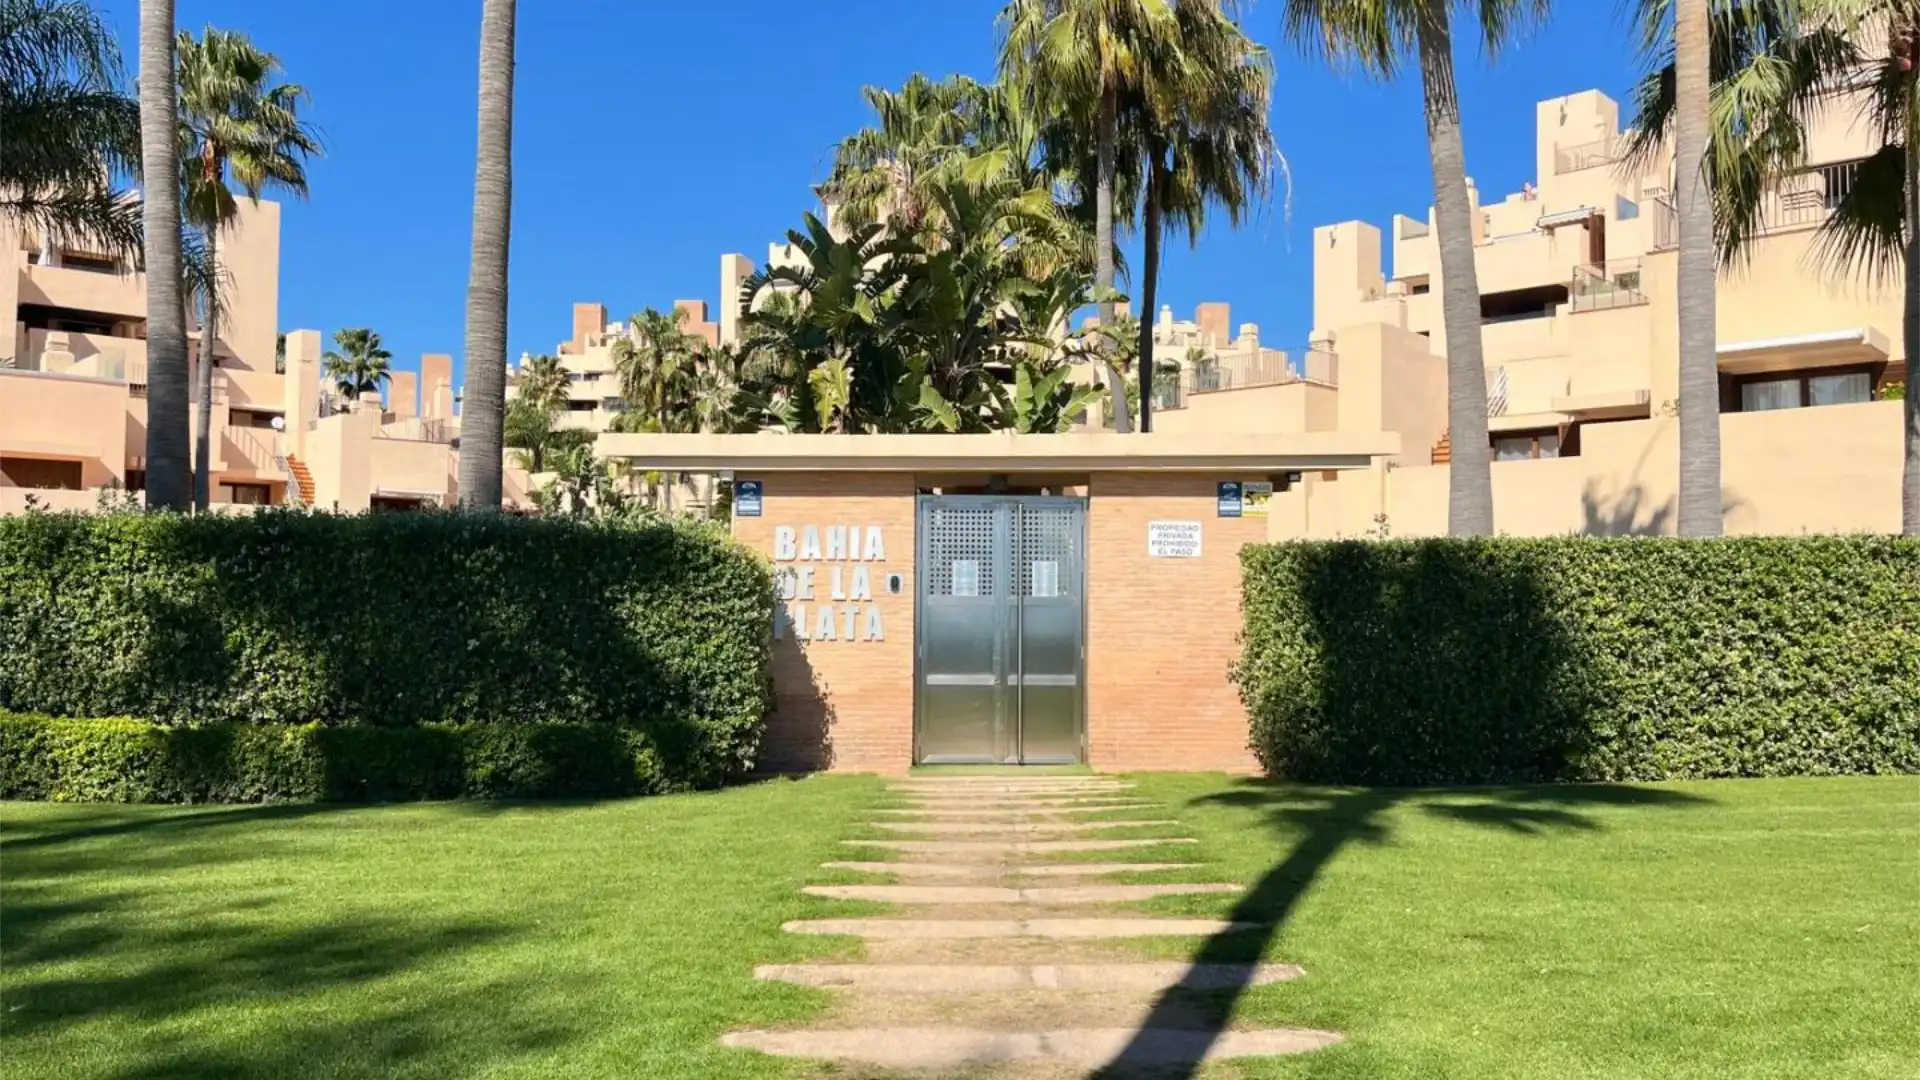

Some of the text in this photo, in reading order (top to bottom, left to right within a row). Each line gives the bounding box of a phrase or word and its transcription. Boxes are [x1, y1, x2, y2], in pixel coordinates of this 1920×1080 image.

[775, 525, 885, 561] BAHIA
[776, 564, 872, 601] DE LA
[774, 604, 885, 641] PLATA
